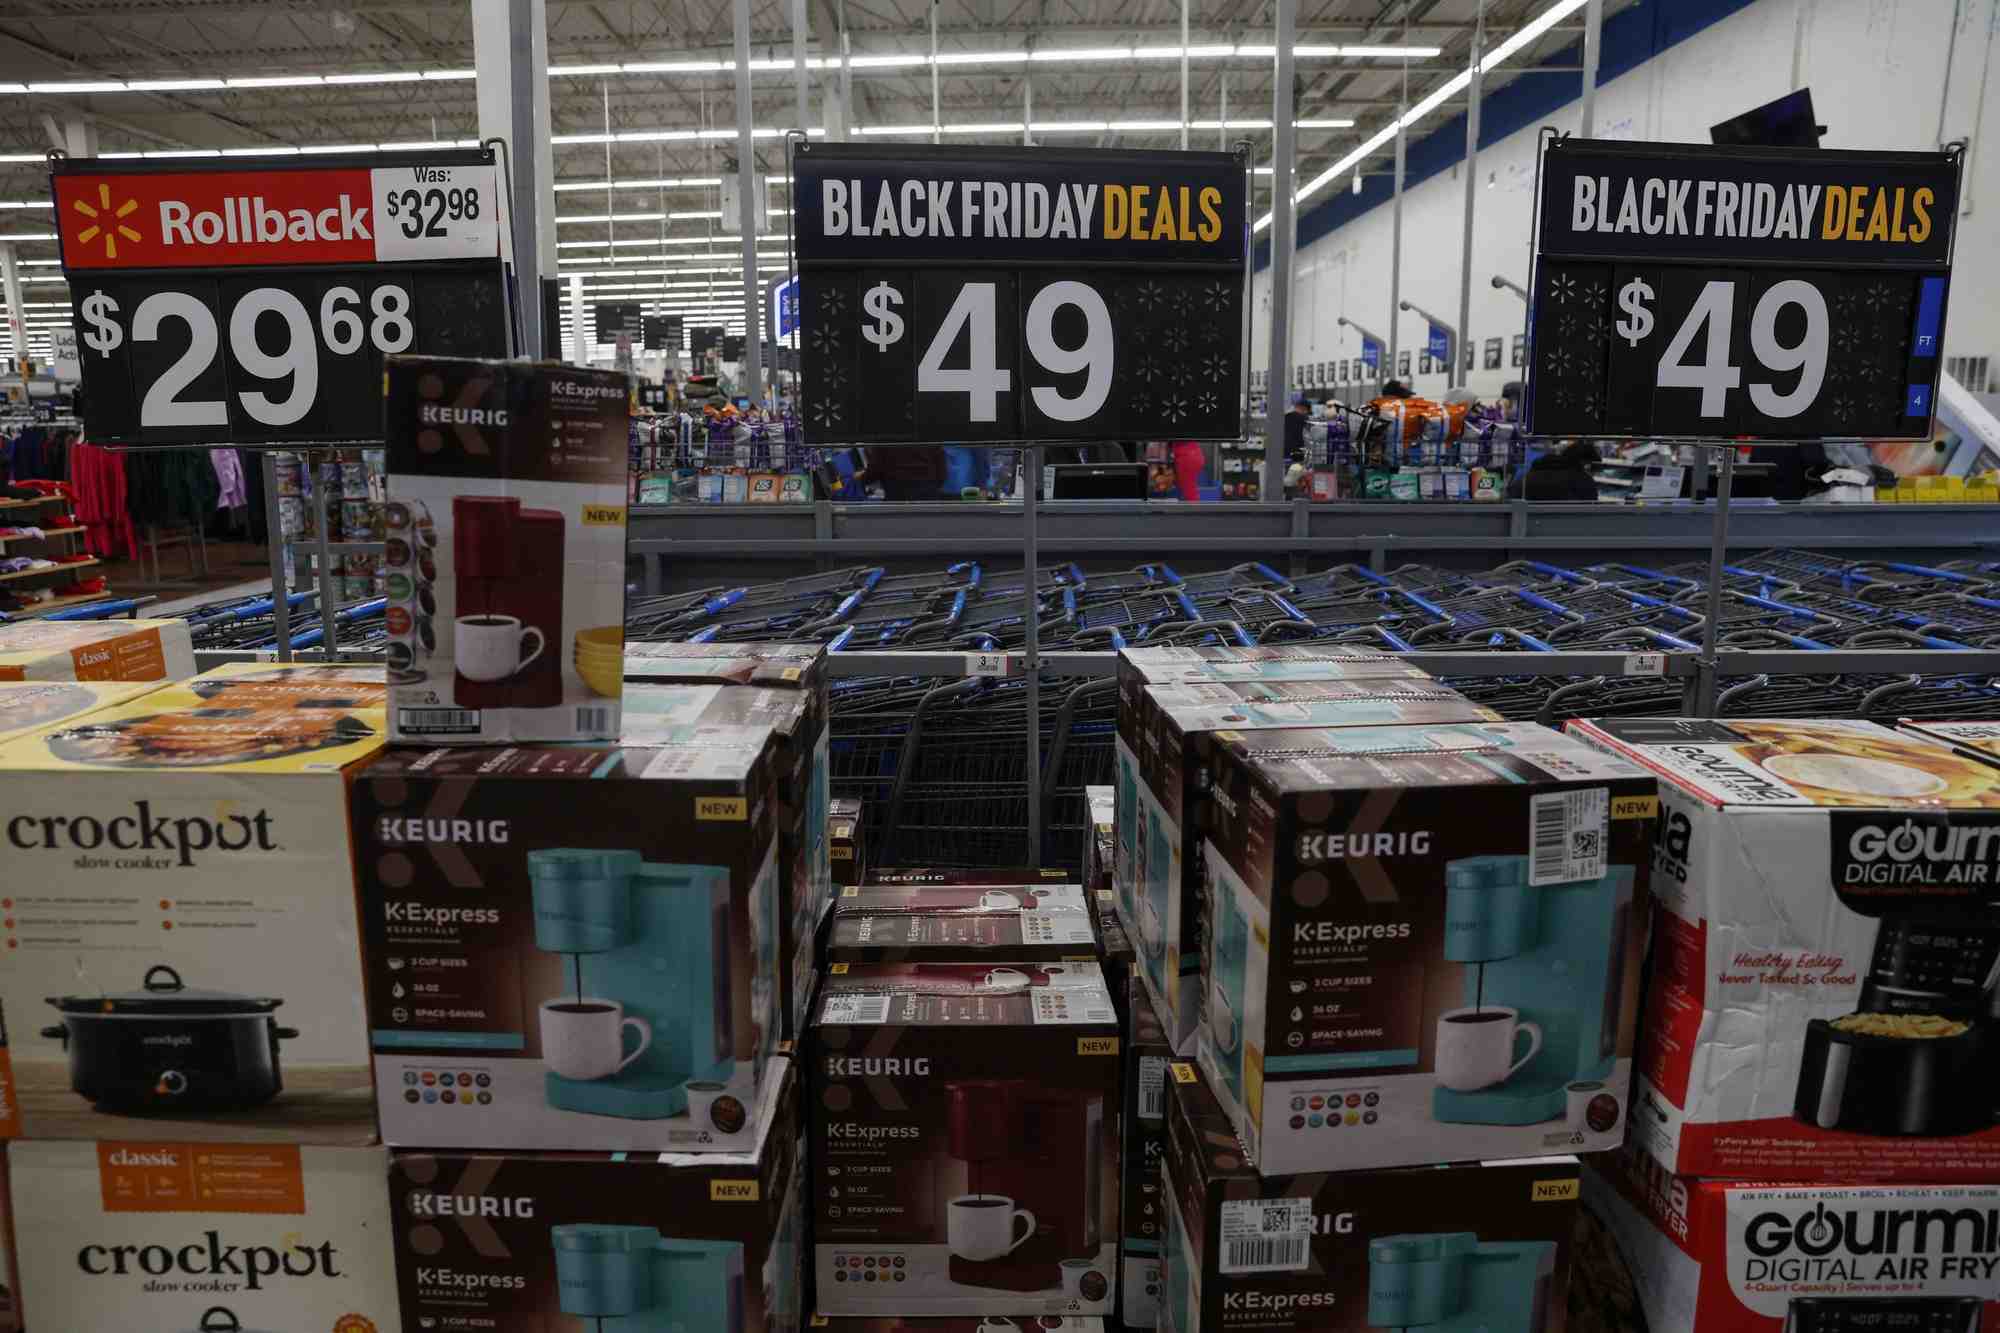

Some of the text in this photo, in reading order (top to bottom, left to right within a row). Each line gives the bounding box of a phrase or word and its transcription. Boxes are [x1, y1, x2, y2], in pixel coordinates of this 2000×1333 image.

[414, 166, 452, 184] Was:
[822, 179, 1222, 243] BLACK FRIDAY DEALS
[1572, 175, 1934, 243] BLACK FRIDAY DEALS
[159, 193, 373, 247] Rollback
[1911, 394, 1921, 408] 4
[421, 405, 509, 427] KEURIG
[587, 509, 621, 523] NEW
[701, 801, 739, 816] NEW
[1615, 801, 1651, 815] NEW
[7, 800, 278, 867] crockpot
[381, 817, 510, 844] KEURIG
[1301, 831, 1431, 859] KEURIG
[73, 855, 172, 870] slow cooker
[1844, 863, 1989, 884] DIGITAL AIR
[1820, 973, 1857, 985] Good
[1081, 1039, 1112, 1053] NEW
[827, 1057, 930, 1077] KEURIG
[108, 1148, 180, 1168] classic
[716, 1183, 751, 1197] NEW
[1536, 1183, 1572, 1197] NEW
[412, 1193, 535, 1219] KEURIG
[78, 1231, 341, 1290] crockpot
[1745, 1257, 1866, 1282] DIGITAL
[1875, 1257, 1929, 1280] AIR
[143, 1280, 240, 1293] slow cooker
[1791, 1282, 1837, 1294] Capacity
[1846, 1282, 1879, 1293] Serves
